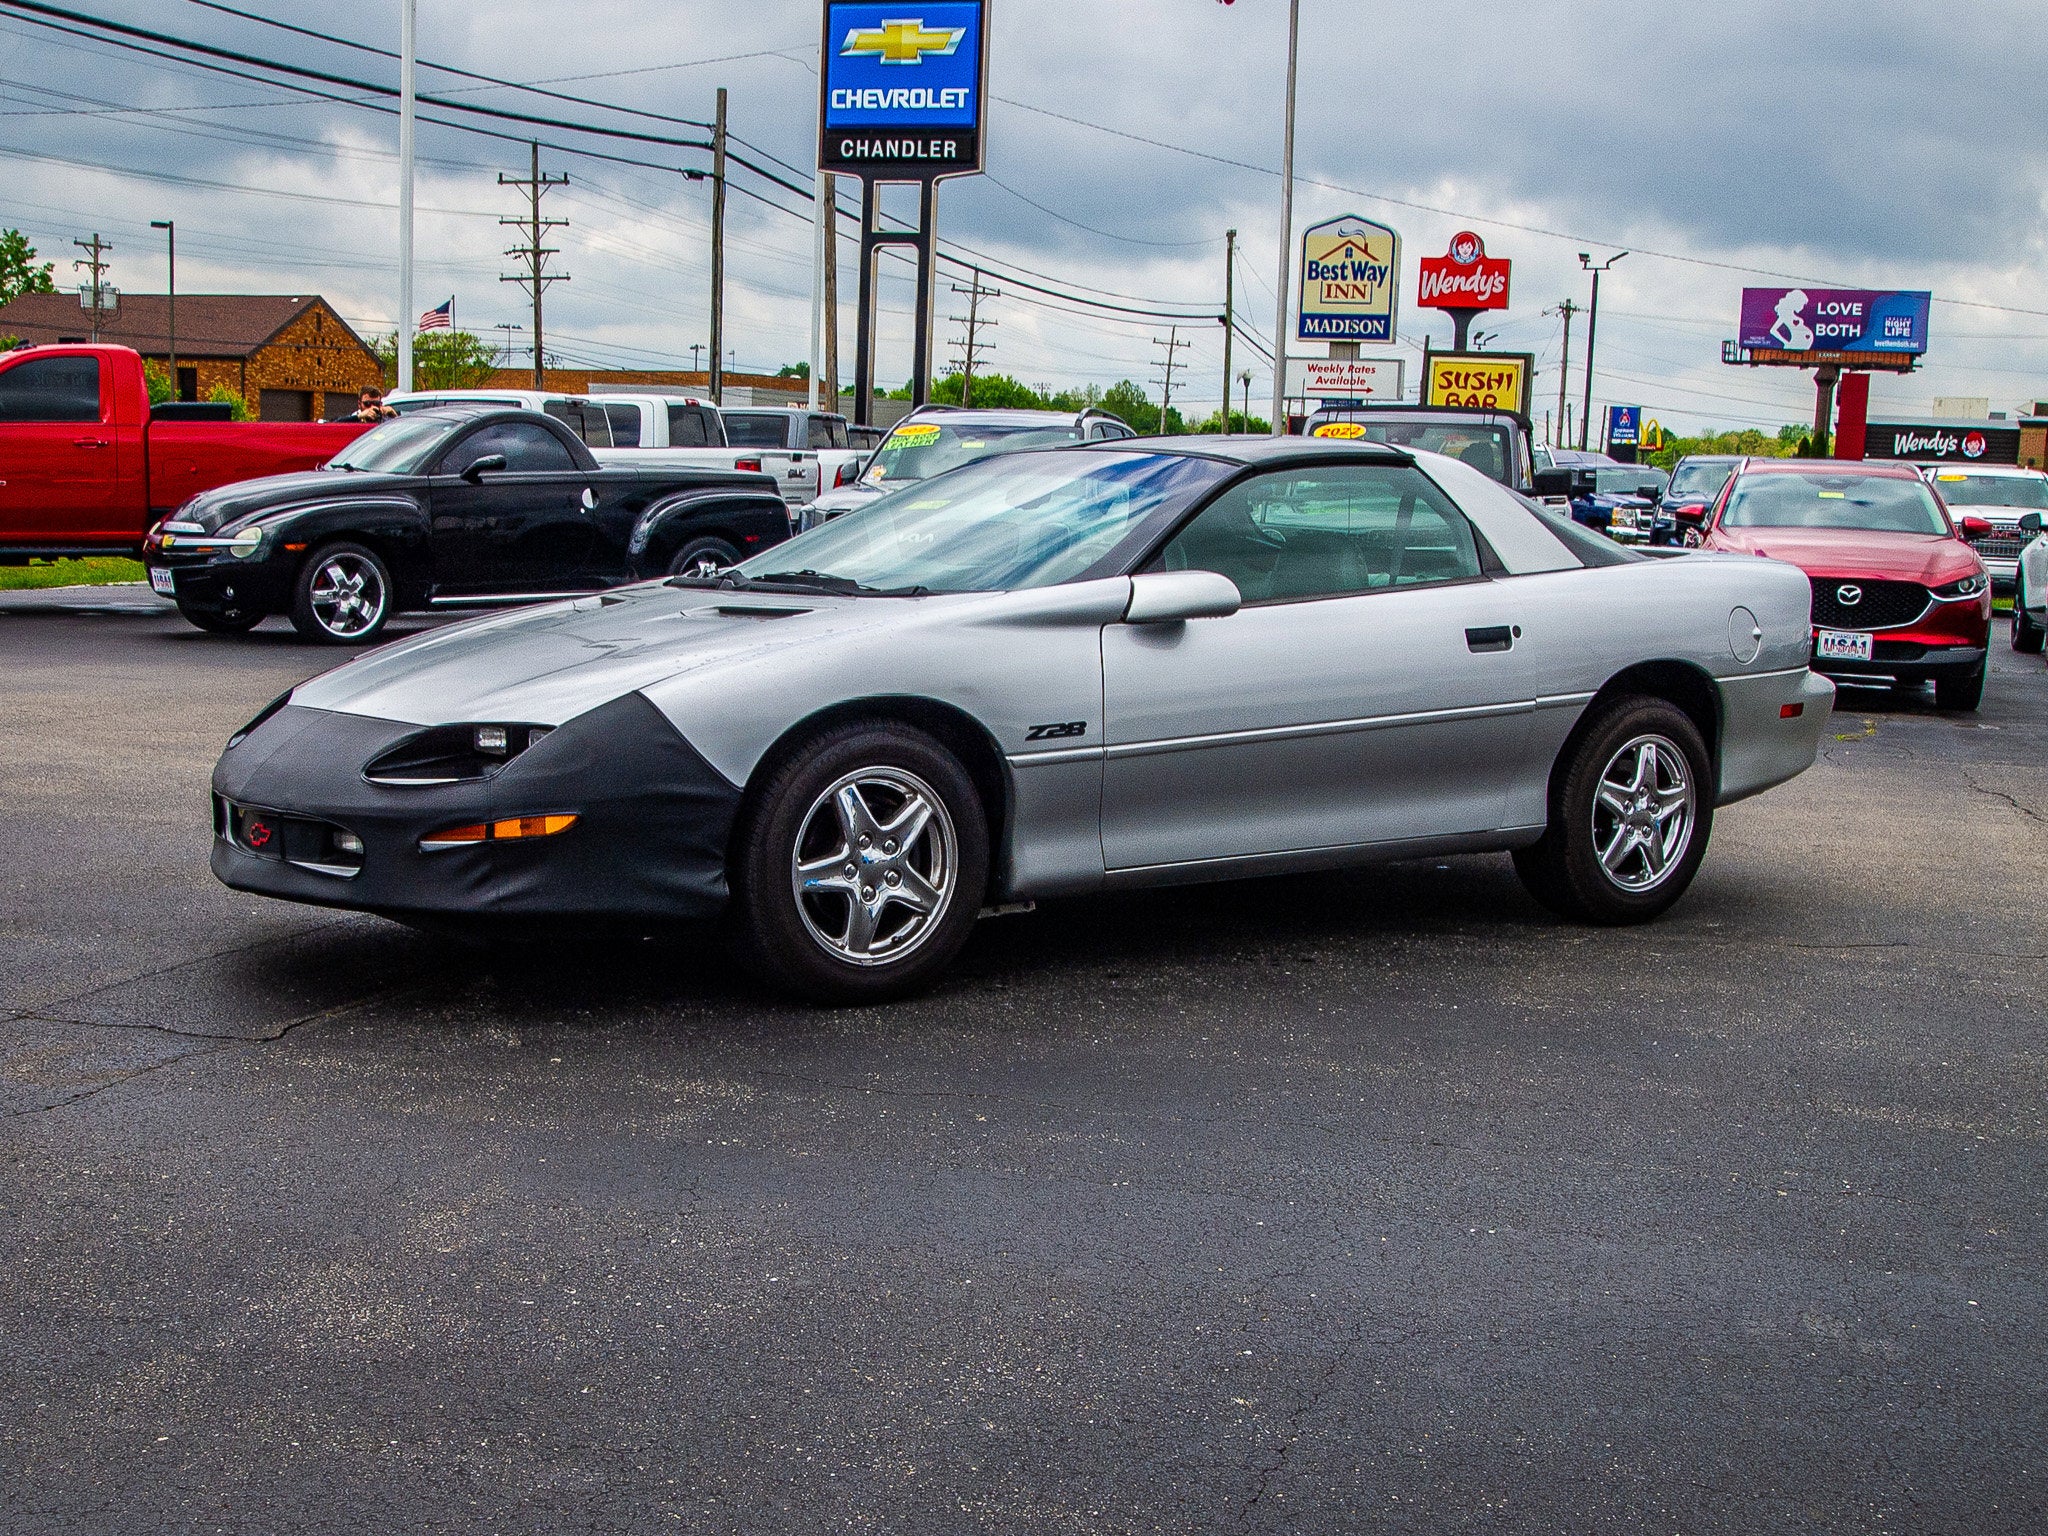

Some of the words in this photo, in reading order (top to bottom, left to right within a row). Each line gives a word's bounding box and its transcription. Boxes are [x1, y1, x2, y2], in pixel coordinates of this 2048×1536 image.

[832, 88, 969, 109] CHEVROLET
[840, 139, 957, 158] CHANDLER
[1308, 259, 1349, 281] Best
[1350, 259, 1389, 288] Way
[1324, 284, 1368, 300] INN
[1420, 267, 1505, 301] Wendy's
[1817, 302, 1863, 316] LOVE
[1304, 317, 1386, 335] MADISON
[1816, 323, 1862, 338] BOTH
[1884, 327, 1911, 337] LIFE
[1885, 320, 1912, 328] RIGHT
[1307, 364, 1345, 375] Weekly
[1347, 364, 1376, 374] Rates
[1315, 375, 1366, 386] Available
[1438, 371, 1513, 391] SUSHI
[1894, 430, 1957, 457] Wendy's
[1025, 720, 1087, 741] Z28
